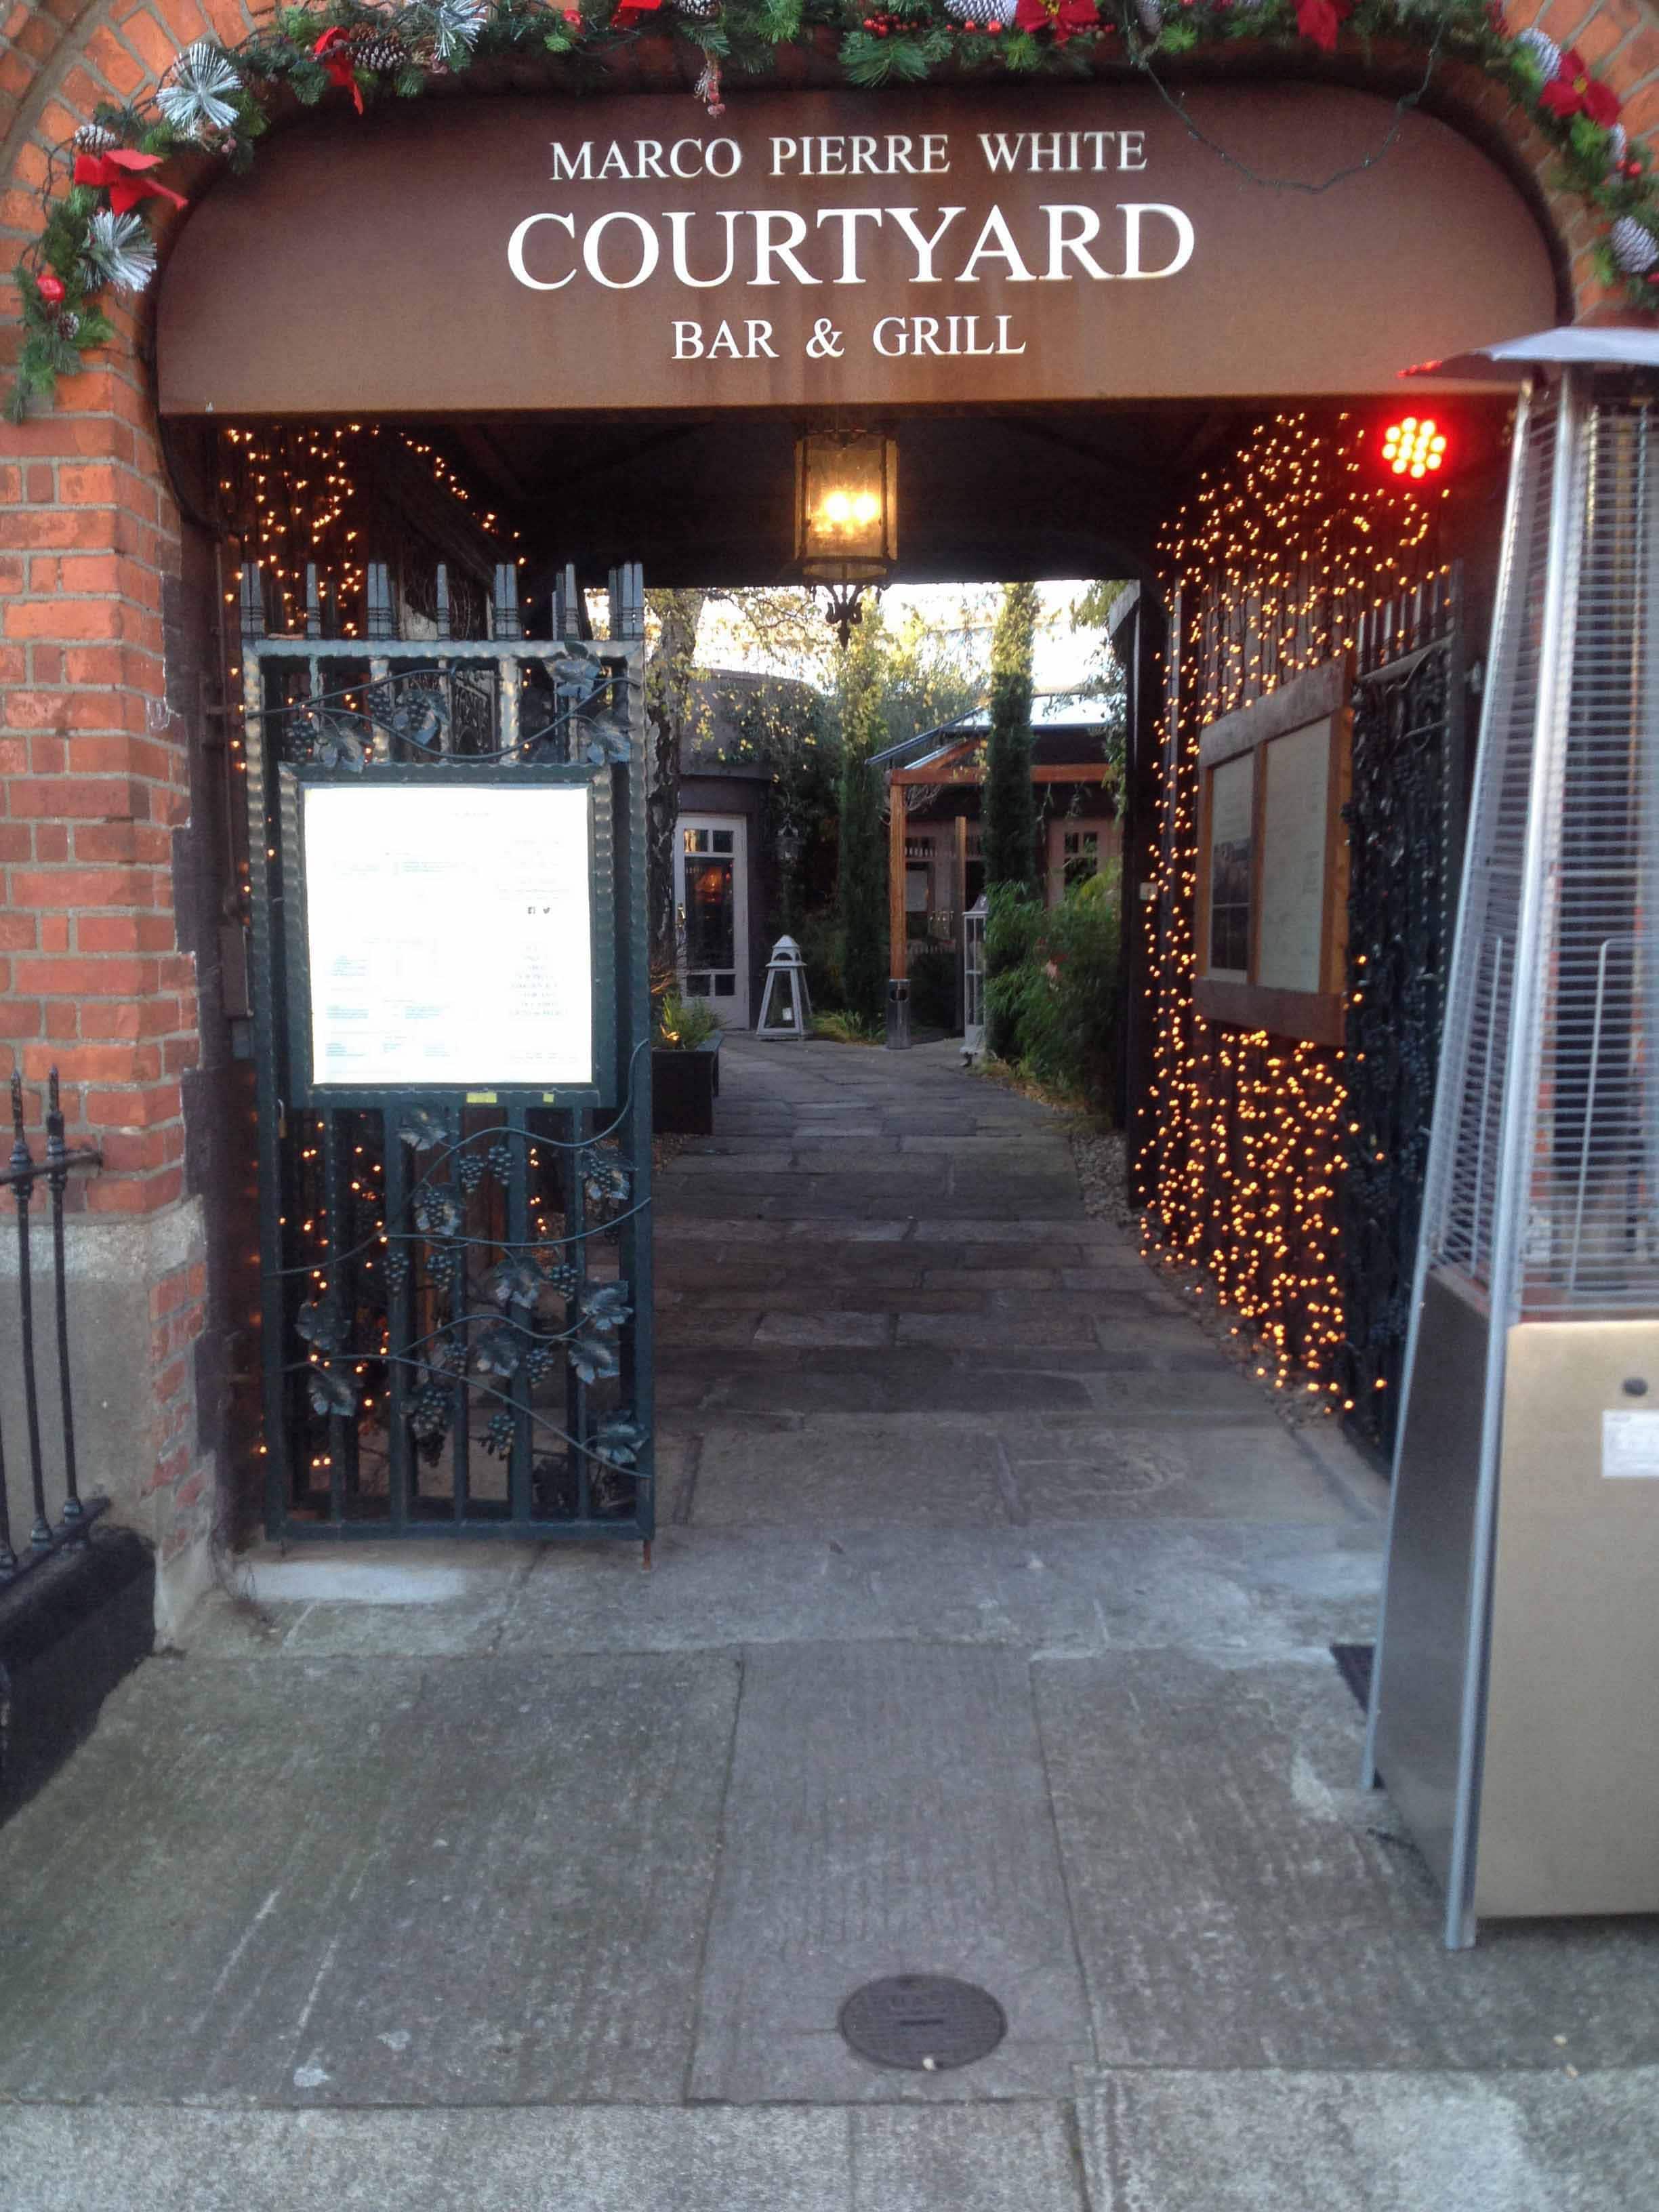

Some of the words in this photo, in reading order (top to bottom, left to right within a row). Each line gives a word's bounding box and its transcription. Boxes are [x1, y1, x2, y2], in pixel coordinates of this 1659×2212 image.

[550, 138, 743, 181] MARCO
[769, 134, 951, 177] PIERRE
[979, 129, 1148, 173] WHITE
[506, 203, 1196, 291] COURTYARD
[670, 319, 781, 361] BAR
[805, 317, 846, 359] &
[871, 314, 1027, 359] GRILL
